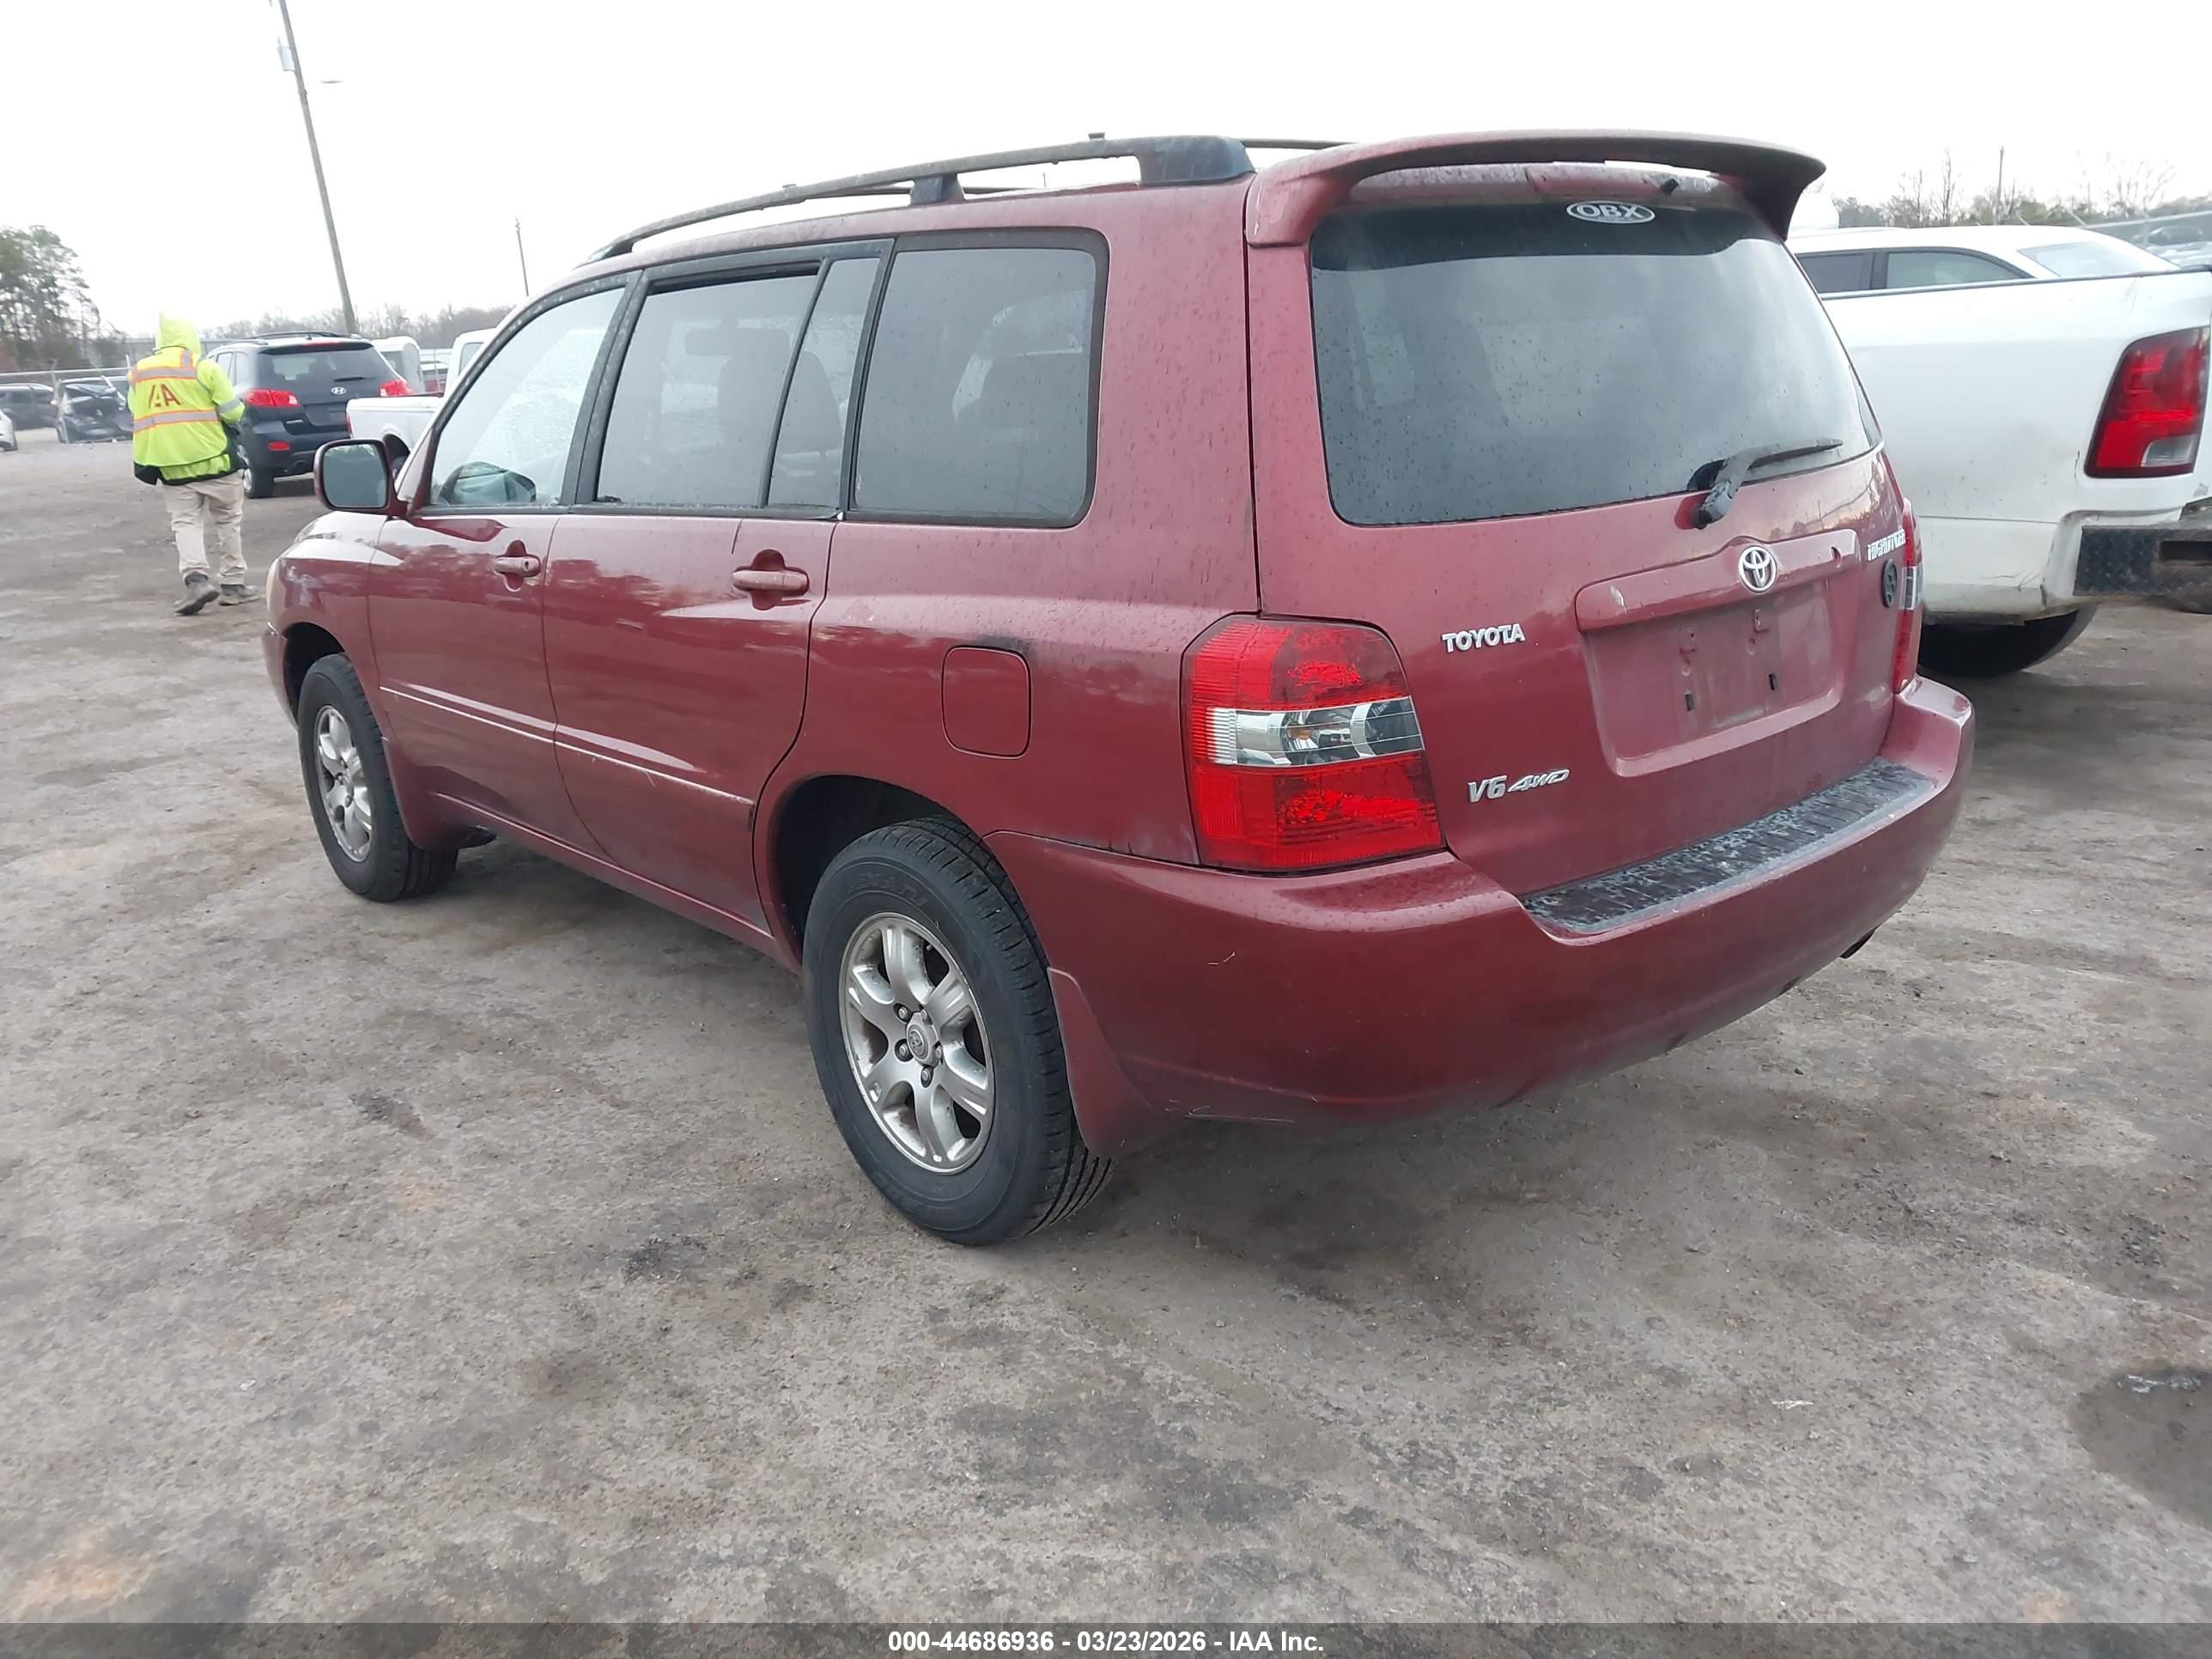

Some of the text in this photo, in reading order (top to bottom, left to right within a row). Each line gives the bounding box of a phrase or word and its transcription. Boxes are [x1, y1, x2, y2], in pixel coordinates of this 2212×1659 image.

[1577, 204, 1644, 218] OBX
[1442, 623, 1526, 653] TOYOTA
[1468, 769, 1570, 803] V6 4WD
